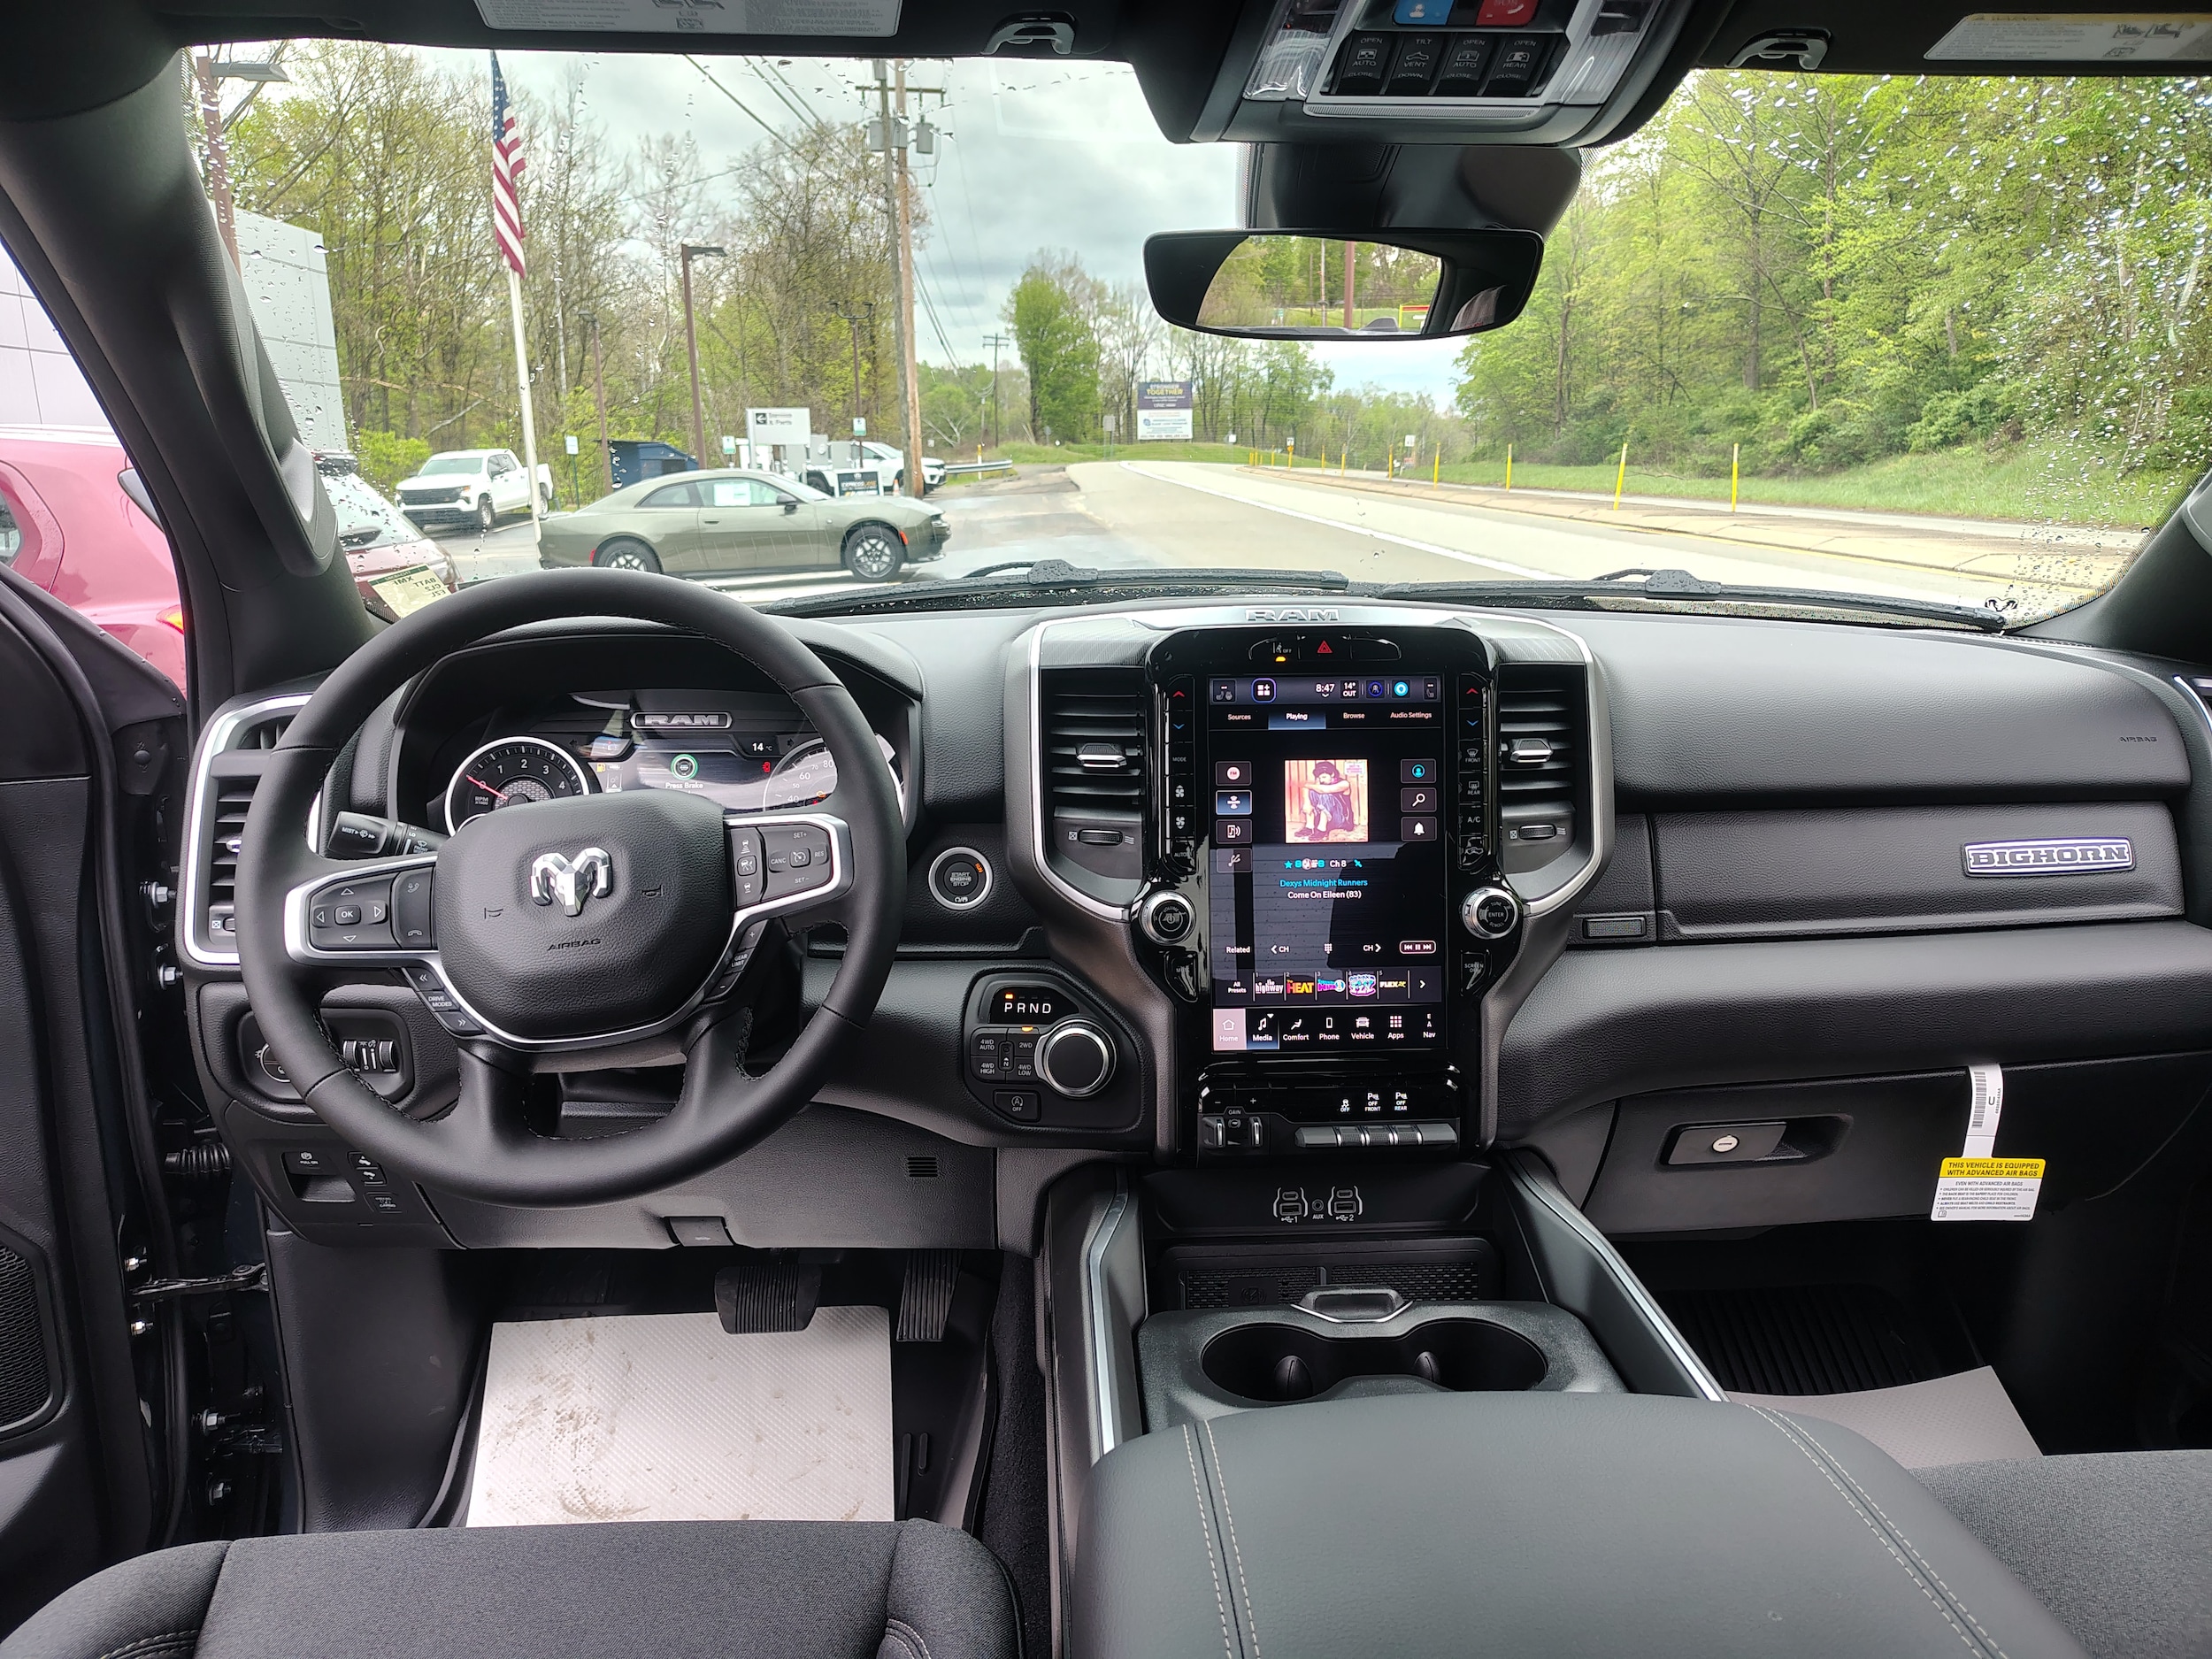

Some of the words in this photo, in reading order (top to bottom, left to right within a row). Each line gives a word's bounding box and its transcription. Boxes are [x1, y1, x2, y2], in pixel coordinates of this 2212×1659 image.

[1245, 609, 1340, 621] RAM
[1316, 683, 1335, 693] 8:47
[644, 715, 719, 726] RAM
[752, 742, 764, 751] 14
[521, 759, 528, 769] 2
[497, 765, 503, 774] 1
[543, 765, 549, 774] 3
[558, 780, 565, 790] 4
[1971, 847, 2127, 866] BIGHORN
[1279, 879, 1302, 888] Dexys
[1302, 879, 1337, 888] Midnight
[1346, 890, 1362, 899] (83)
[547, 938, 602, 951] AIRBAG
[1256, 982, 1284, 994] highway
[1286, 982, 1314, 994] HEAT
[1004, 1002, 1013, 1013] P
[1017, 1002, 1025, 1013] R
[1029, 1002, 1039, 1013] N
[1042, 1003, 1052, 1014] D
[1387, 1032, 1404, 1041] Apps
[1988, 1095, 1995, 1106] U
